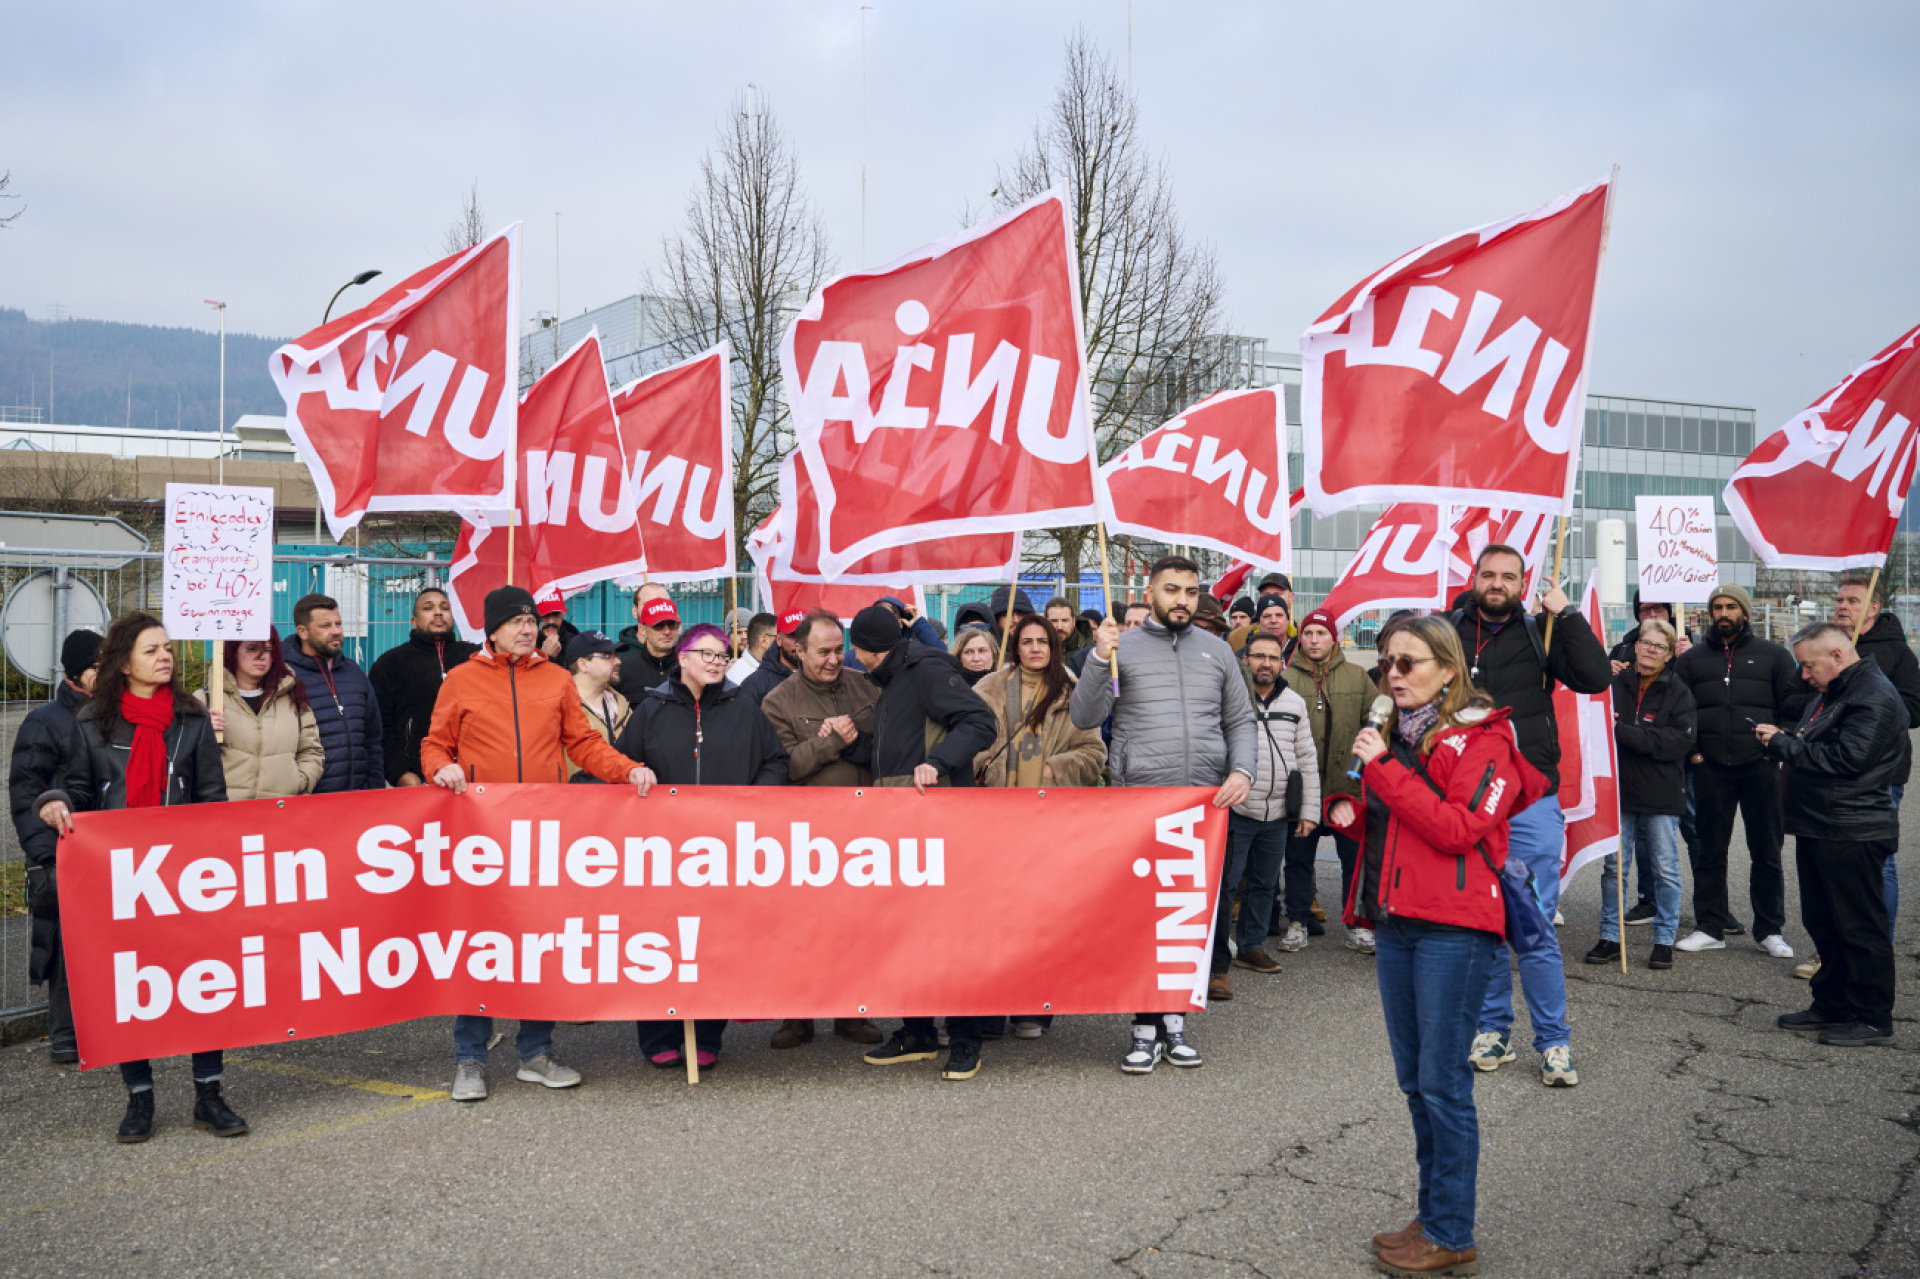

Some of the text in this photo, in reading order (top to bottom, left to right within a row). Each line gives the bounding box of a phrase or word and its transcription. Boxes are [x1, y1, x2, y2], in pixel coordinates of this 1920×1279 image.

[1658, 539, 1680, 558] 0%
[187, 579, 207, 591] bei
[216, 572, 263, 598] 40%
[1641, 563, 1682, 585] 100%
[111, 820, 946, 920] Kein Stellenabbau
[114, 915, 701, 1023] bei Novartis!
